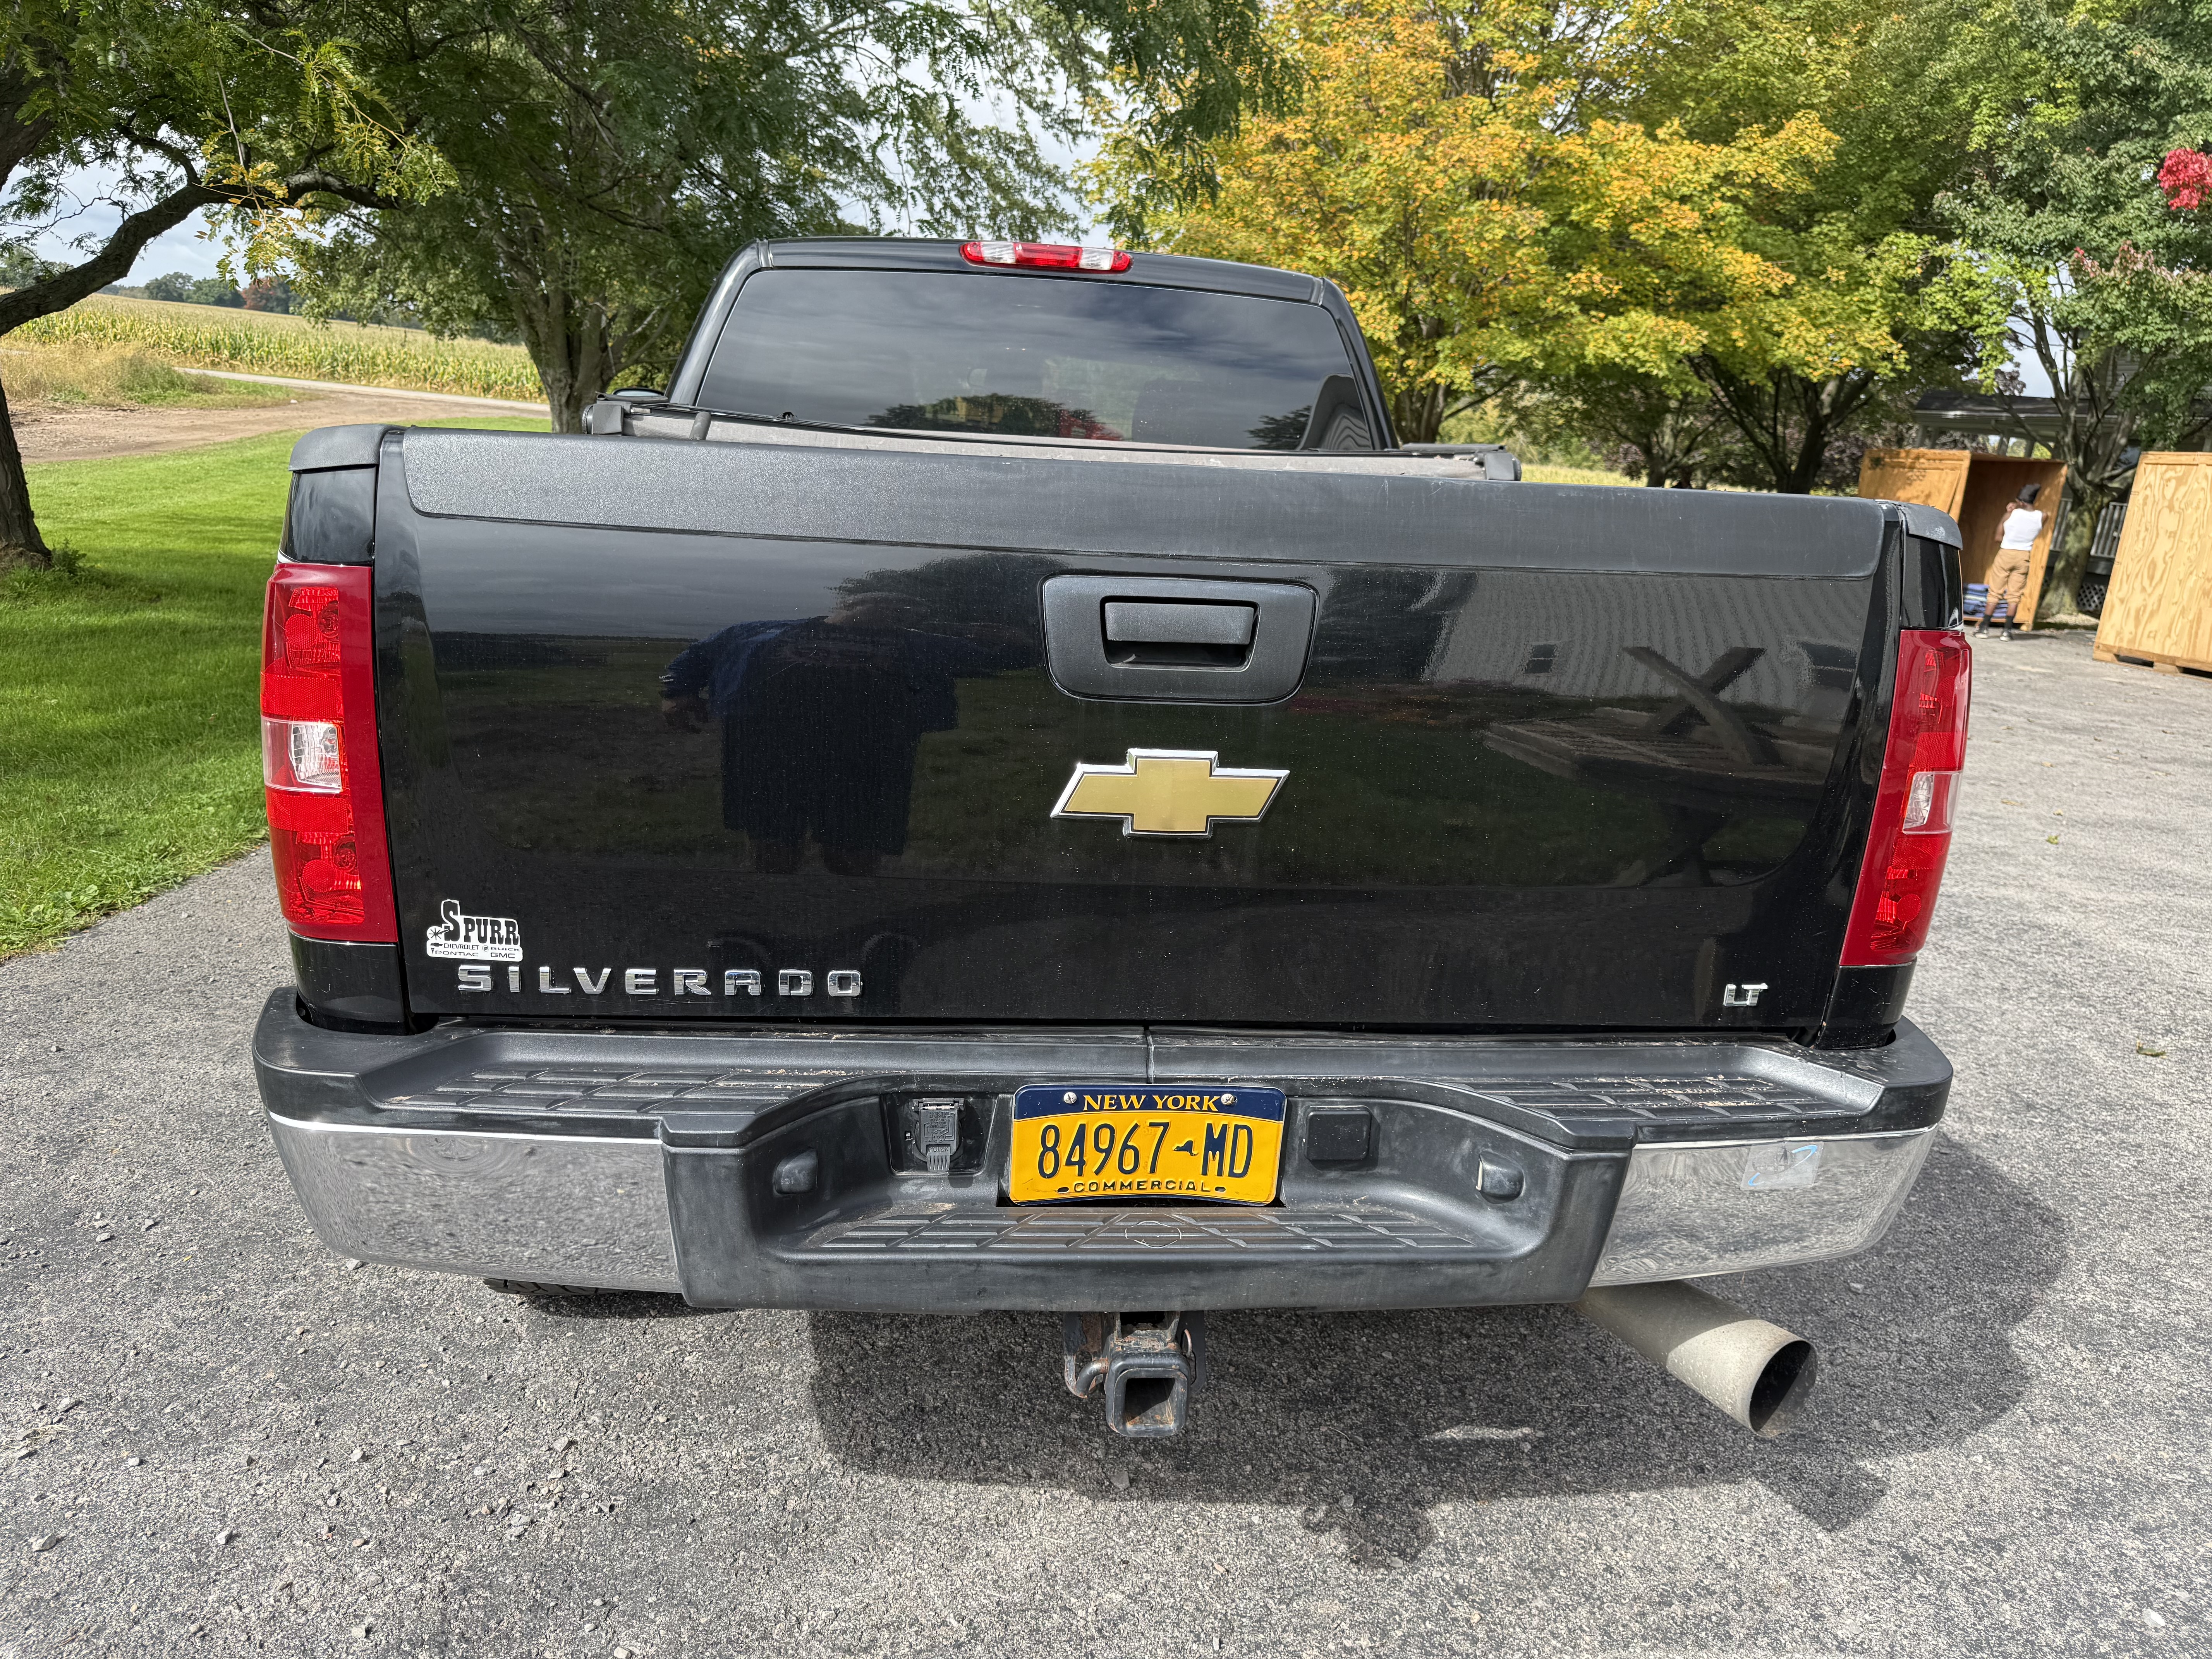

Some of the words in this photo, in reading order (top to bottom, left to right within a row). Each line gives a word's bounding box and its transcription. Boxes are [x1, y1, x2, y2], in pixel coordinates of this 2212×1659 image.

[443, 901, 519, 945] SPURR
[458, 964, 862, 997] SILVERADO
[1724, 983, 1768, 1006] LT
[1083, 1095, 1146, 1110] NEW
[1153, 1095, 1219, 1112] YORK
[1037, 1121, 1170, 1179] 84967
[1200, 1123, 1253, 1178] MD
[1073, 1180, 1211, 1192] COMMERCIAL
